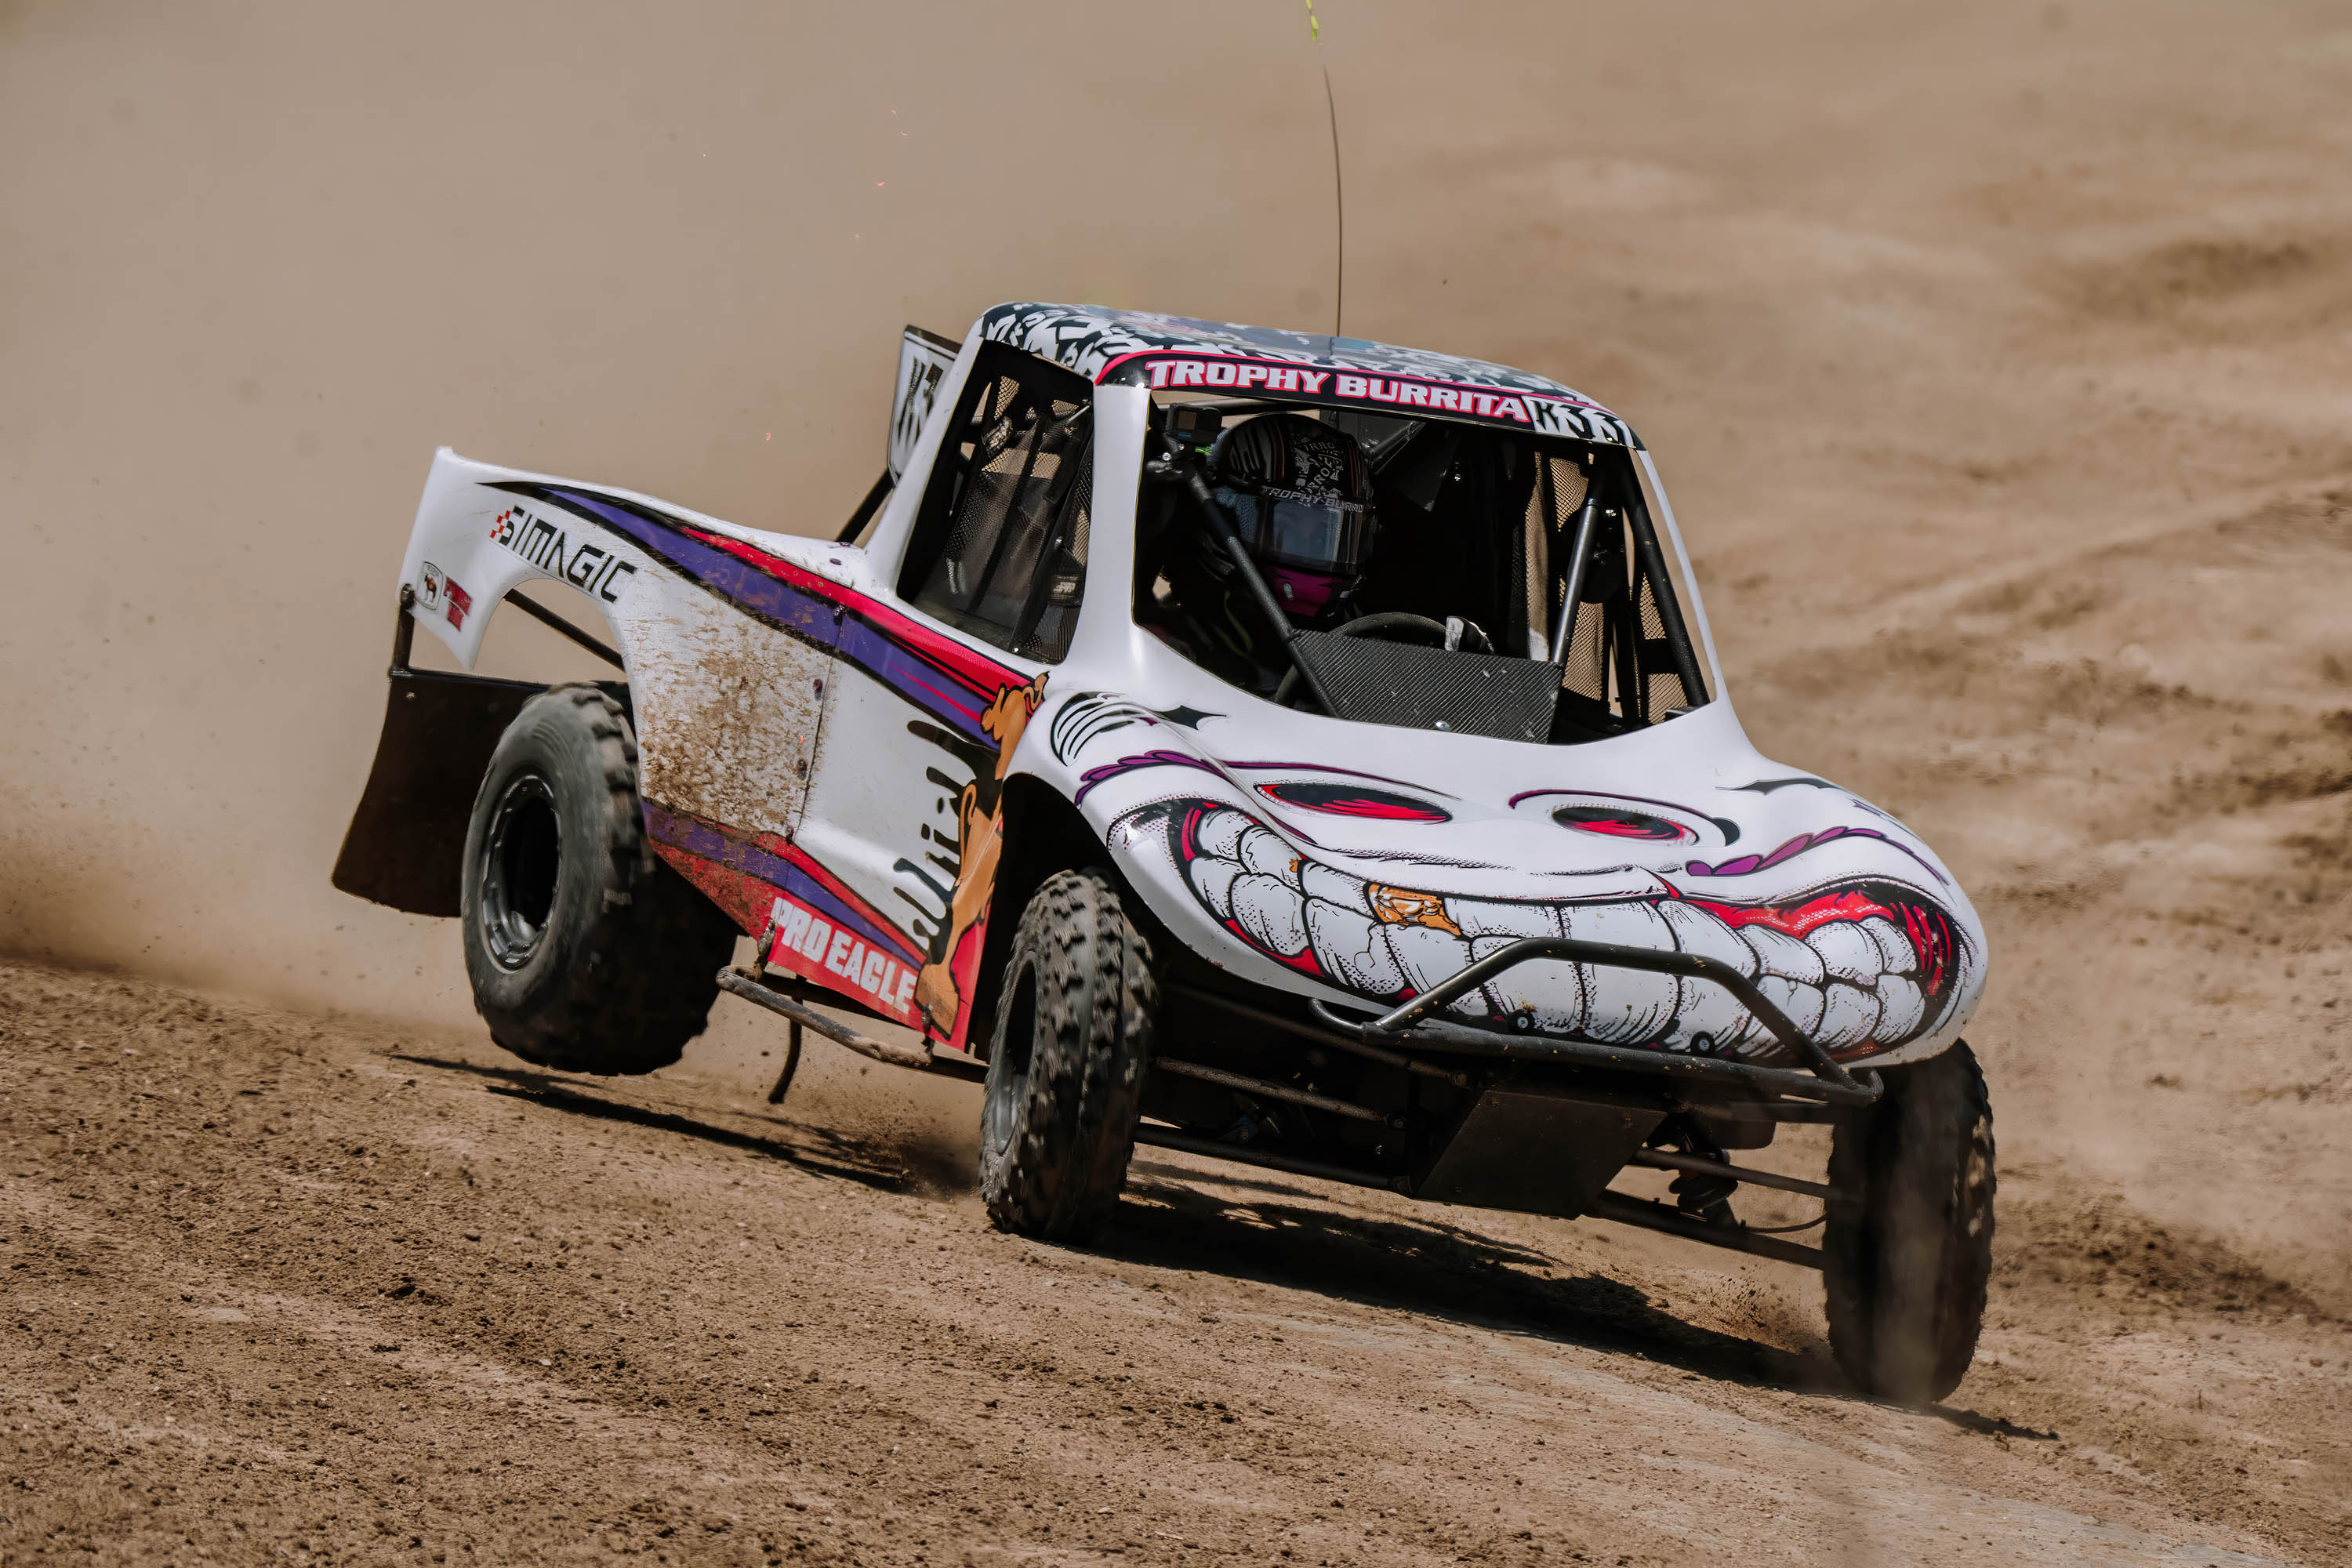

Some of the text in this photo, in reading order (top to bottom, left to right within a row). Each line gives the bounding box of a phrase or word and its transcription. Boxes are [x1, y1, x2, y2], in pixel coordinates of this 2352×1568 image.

[1145, 359, 1330, 394] TROPHY
[1336, 373, 1532, 423] BURRITA
[489, 505, 637, 603] SIMAGIC
[771, 897, 917, 1014] PRO EAGLE
